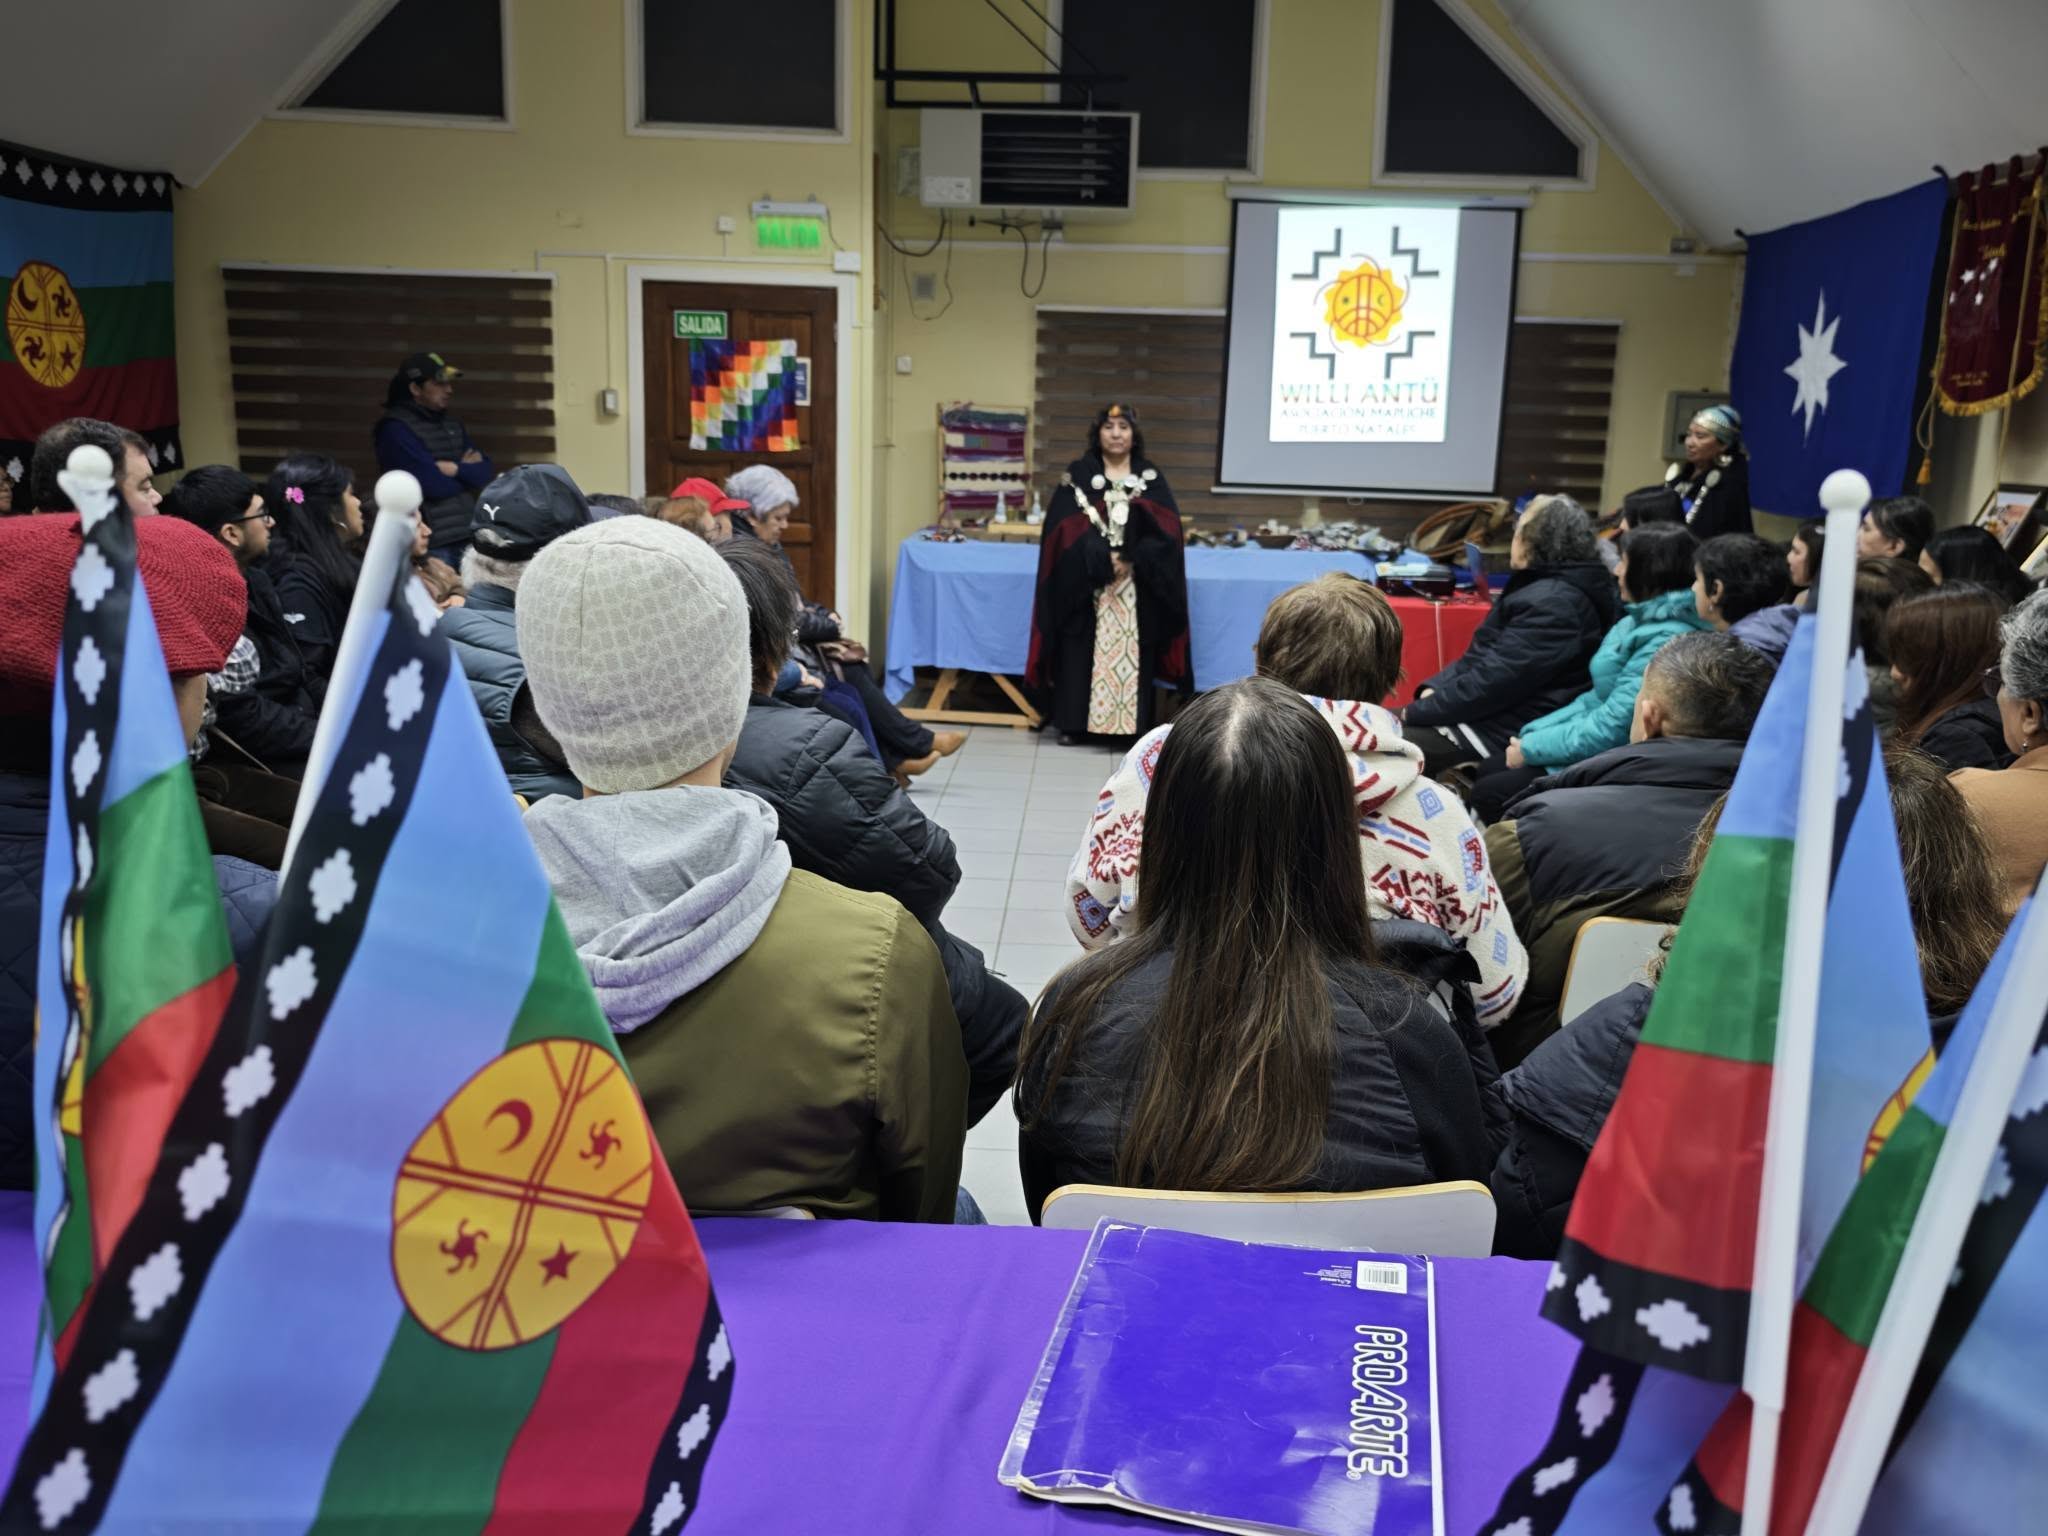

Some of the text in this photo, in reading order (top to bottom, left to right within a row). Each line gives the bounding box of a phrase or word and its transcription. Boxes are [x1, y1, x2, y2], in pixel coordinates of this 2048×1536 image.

[757, 218, 821, 248] SALIDA
[679, 315, 723, 335] SALIDA
[1280, 376, 1439, 404] WILLI ANTÜ
[1347, 1324, 1408, 1479] PROARTE
